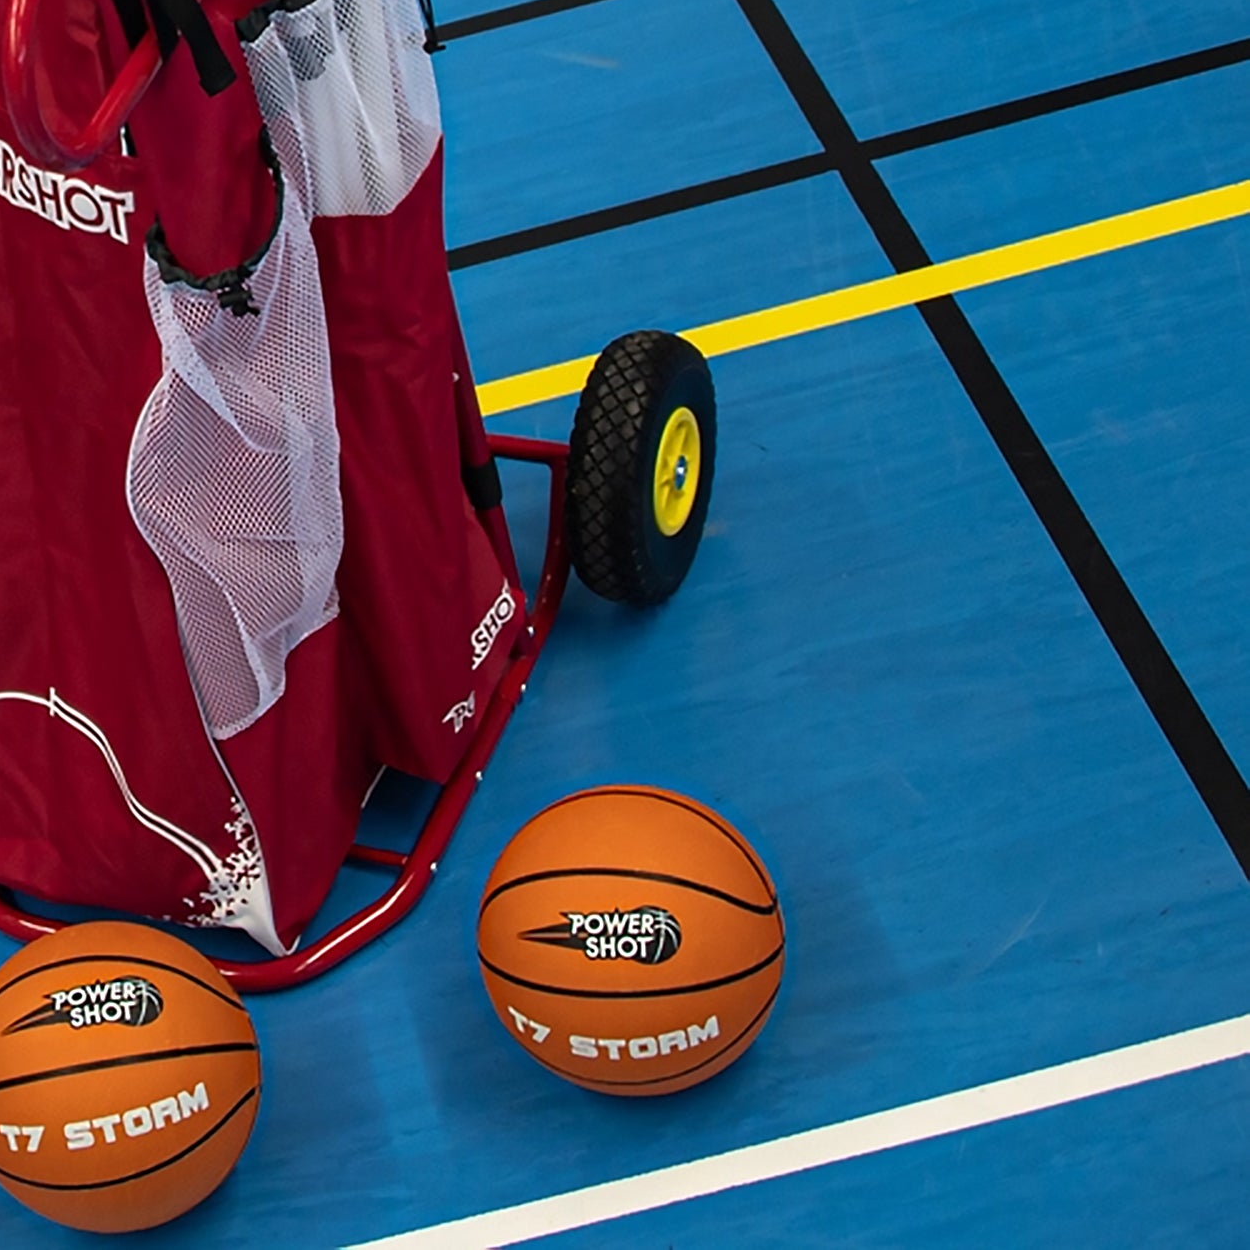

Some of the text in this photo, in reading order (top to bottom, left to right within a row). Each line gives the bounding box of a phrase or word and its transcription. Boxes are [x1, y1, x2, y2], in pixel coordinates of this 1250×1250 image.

[568, 912, 655, 934] POWER
[586, 936, 655, 958] SHOT
[51, 980, 137, 1011] POWER
[70, 1001, 136, 1028] SHOT
[507, 1005, 721, 1060] T7 STORM
[0, 1082, 210, 1153] T7 STORM
